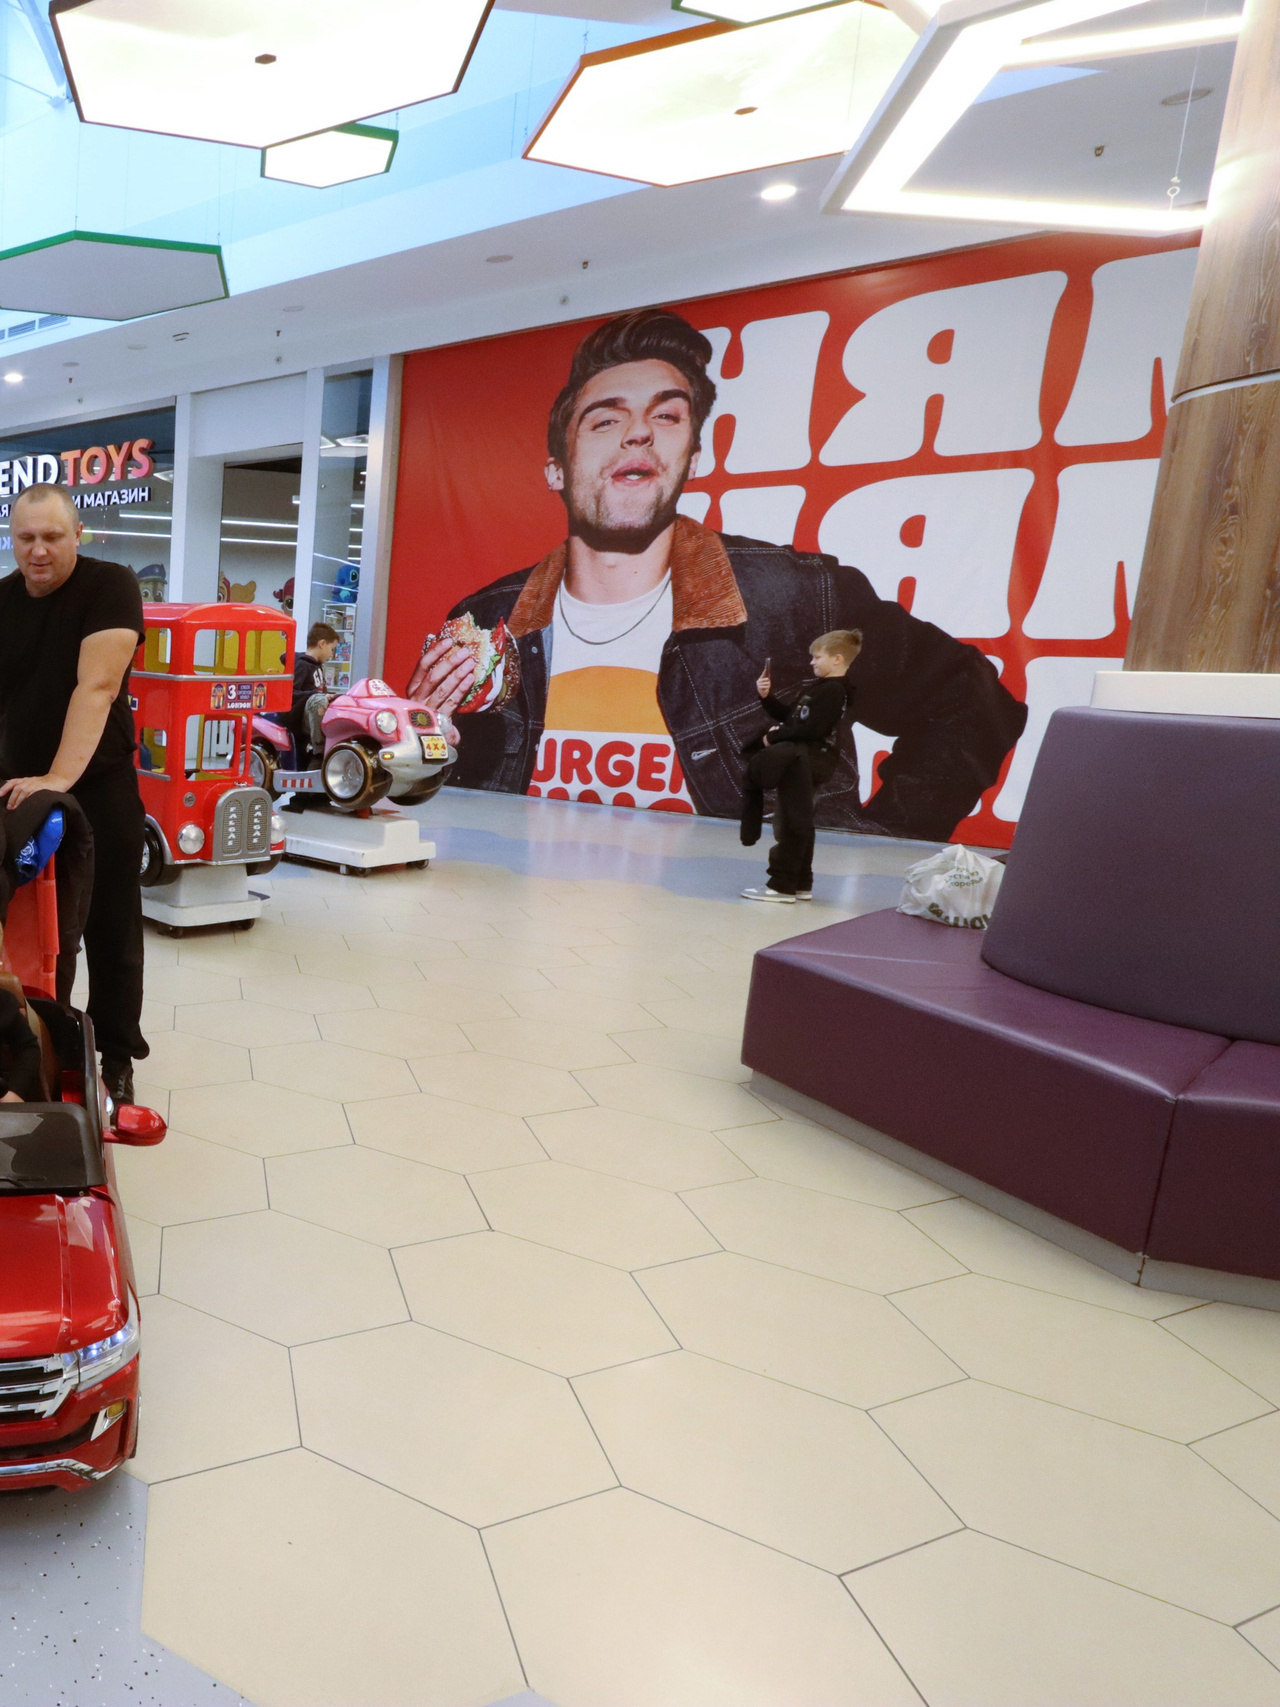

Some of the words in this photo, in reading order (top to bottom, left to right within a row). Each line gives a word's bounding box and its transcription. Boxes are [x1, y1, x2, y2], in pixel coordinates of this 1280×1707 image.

[83, 487, 149, 509] МАГАЗИН
[227, 684, 237, 700] 3
[227, 806, 238, 846] FALGAS
[252, 804, 262, 844] FALGAS
